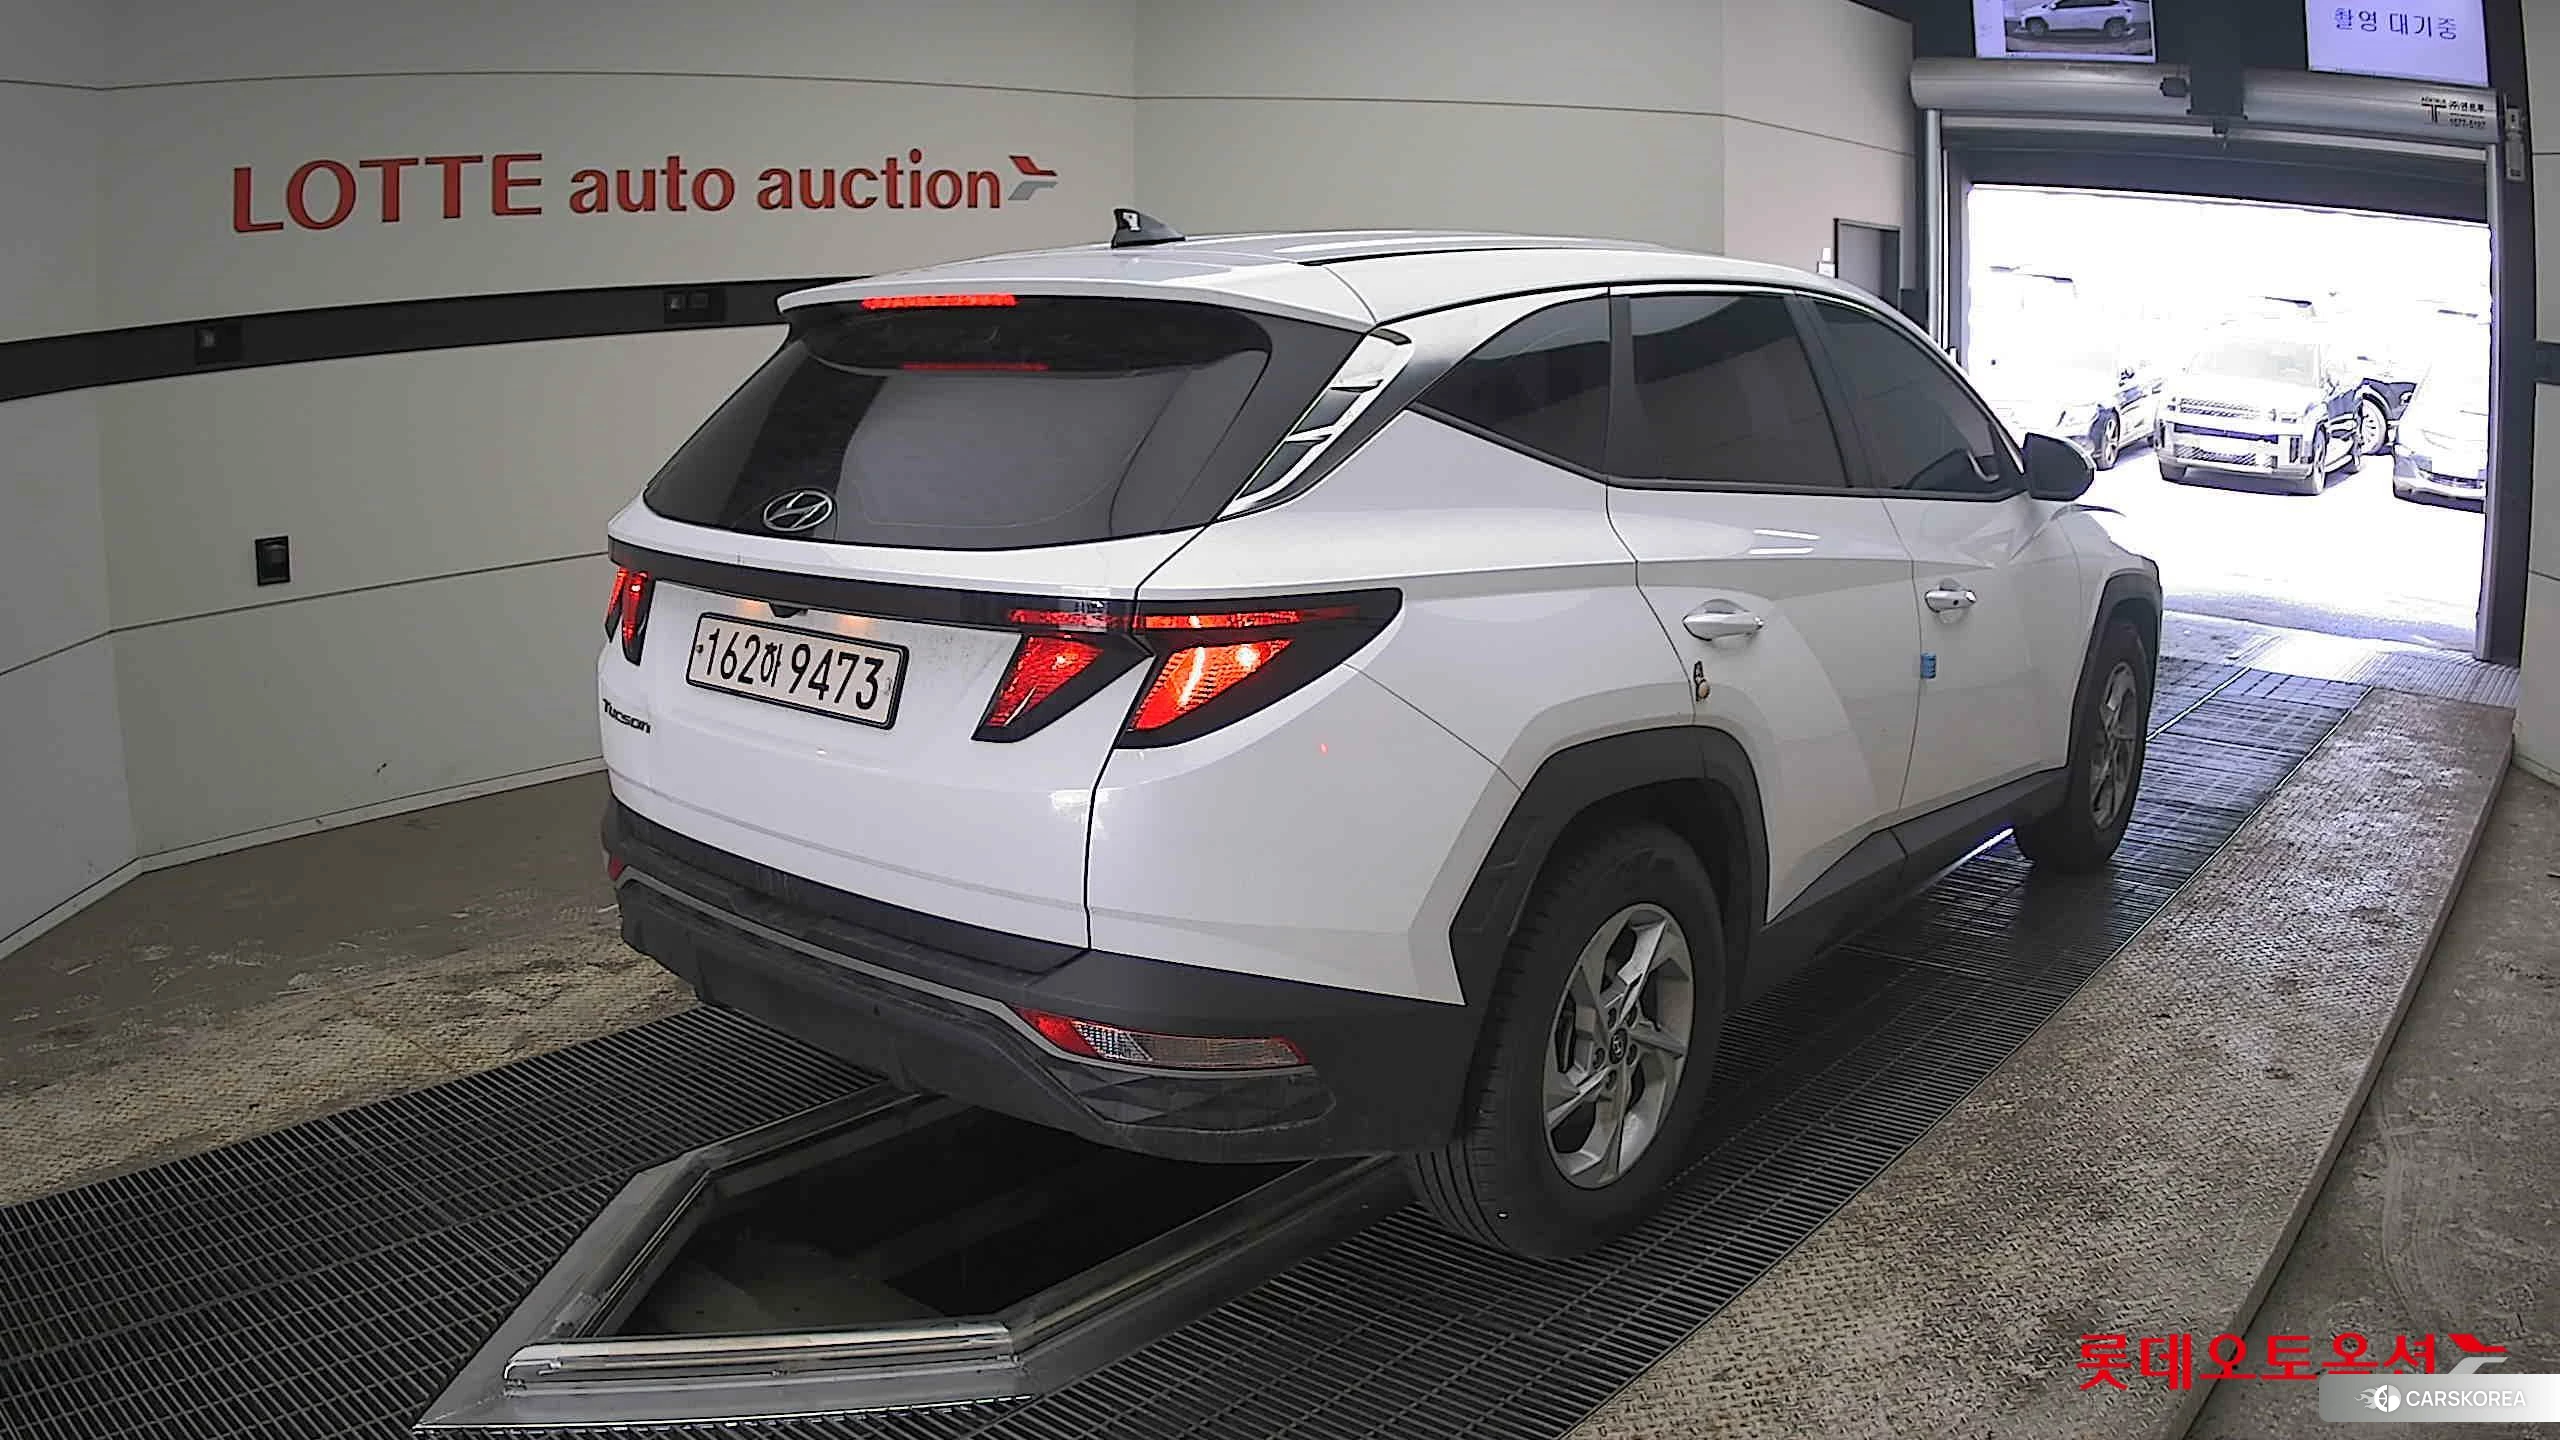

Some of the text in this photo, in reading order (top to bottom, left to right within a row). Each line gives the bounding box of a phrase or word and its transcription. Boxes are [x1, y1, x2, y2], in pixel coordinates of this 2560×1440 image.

[2335, 7, 2457, 40] 촬영 대기중
[233, 148, 1002, 233] LOTTE auto auction
[706, 628, 885, 710] 162하 9473
